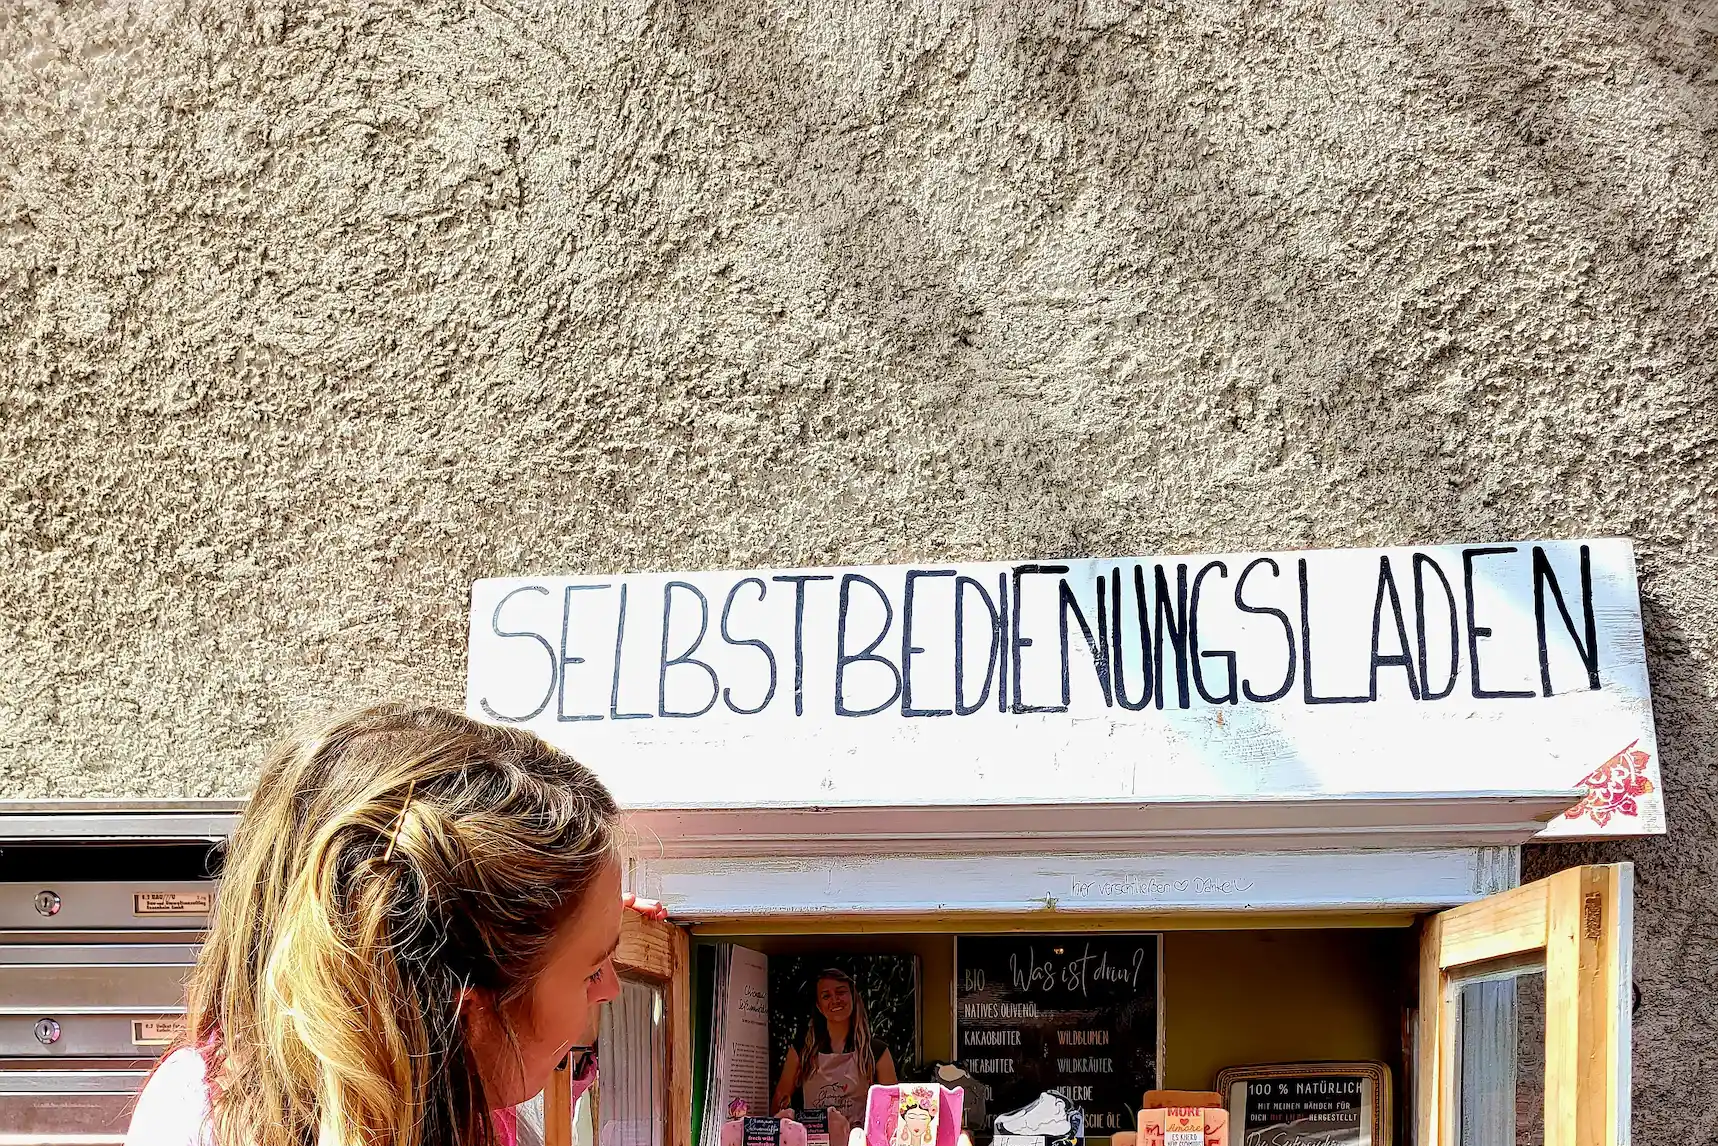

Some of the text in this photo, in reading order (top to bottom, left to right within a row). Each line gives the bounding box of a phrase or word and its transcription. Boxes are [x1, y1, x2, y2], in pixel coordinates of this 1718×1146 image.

[479, 543, 1602, 723] SELBSTBEDIENUNGSLADEN
[1071, 876, 1095, 897] hier
[1010, 943, 1144, 997] Was ist drin?
[965, 968, 985, 991] BIO
[965, 1001, 1038, 1018] NATIVES OLIVENÖL
[965, 1030, 1021, 1046] KAKAOBUTTER
[1057, 1030, 1109, 1045] WILDBLUMEN
[1057, 1056, 1113, 1073] WILDKRÄUTER
[1249, 1081, 1363, 1096] 100 % NATÜRLICH
[1167, 1107, 1201, 1117] MORE
[1257, 1101, 1351, 1110] MIT MEINEN HÄNDEN FÜR
[1106, 1111, 1121, 1129] ÖLE
[1250, 1113, 1267, 1121] DICH
[1308, 1113, 1357, 1121] HERGESTELLT
